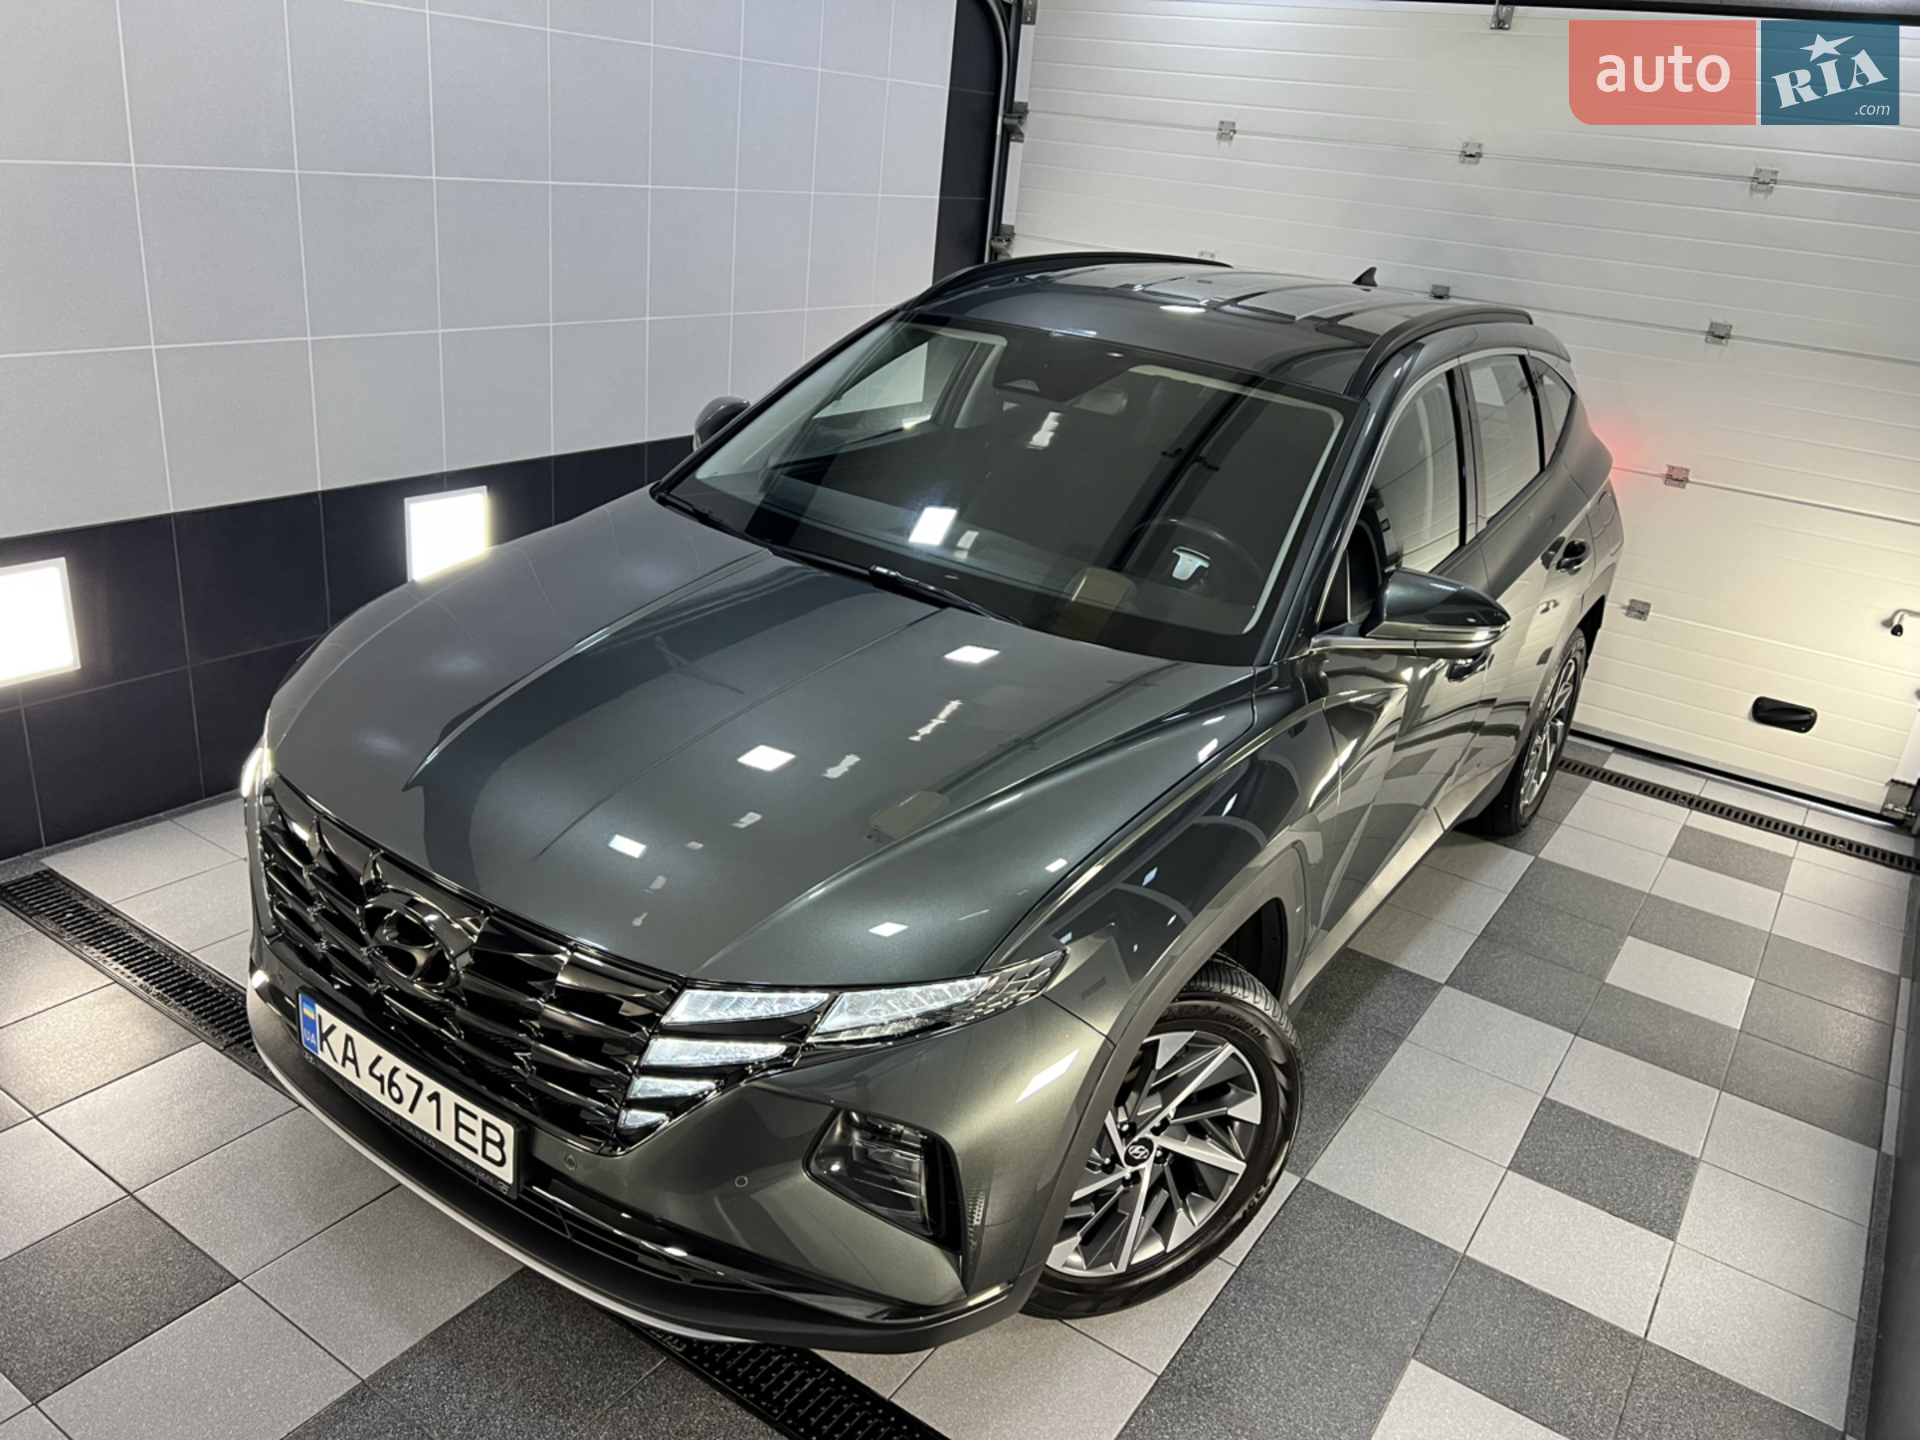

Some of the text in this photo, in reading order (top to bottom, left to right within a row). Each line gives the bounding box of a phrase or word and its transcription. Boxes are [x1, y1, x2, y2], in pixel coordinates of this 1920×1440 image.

[304, 1028, 316, 1047] UA
[318, 1014, 361, 1079] KA
[368, 1055, 441, 1132] 4671
[454, 1102, 506, 1167] EB
